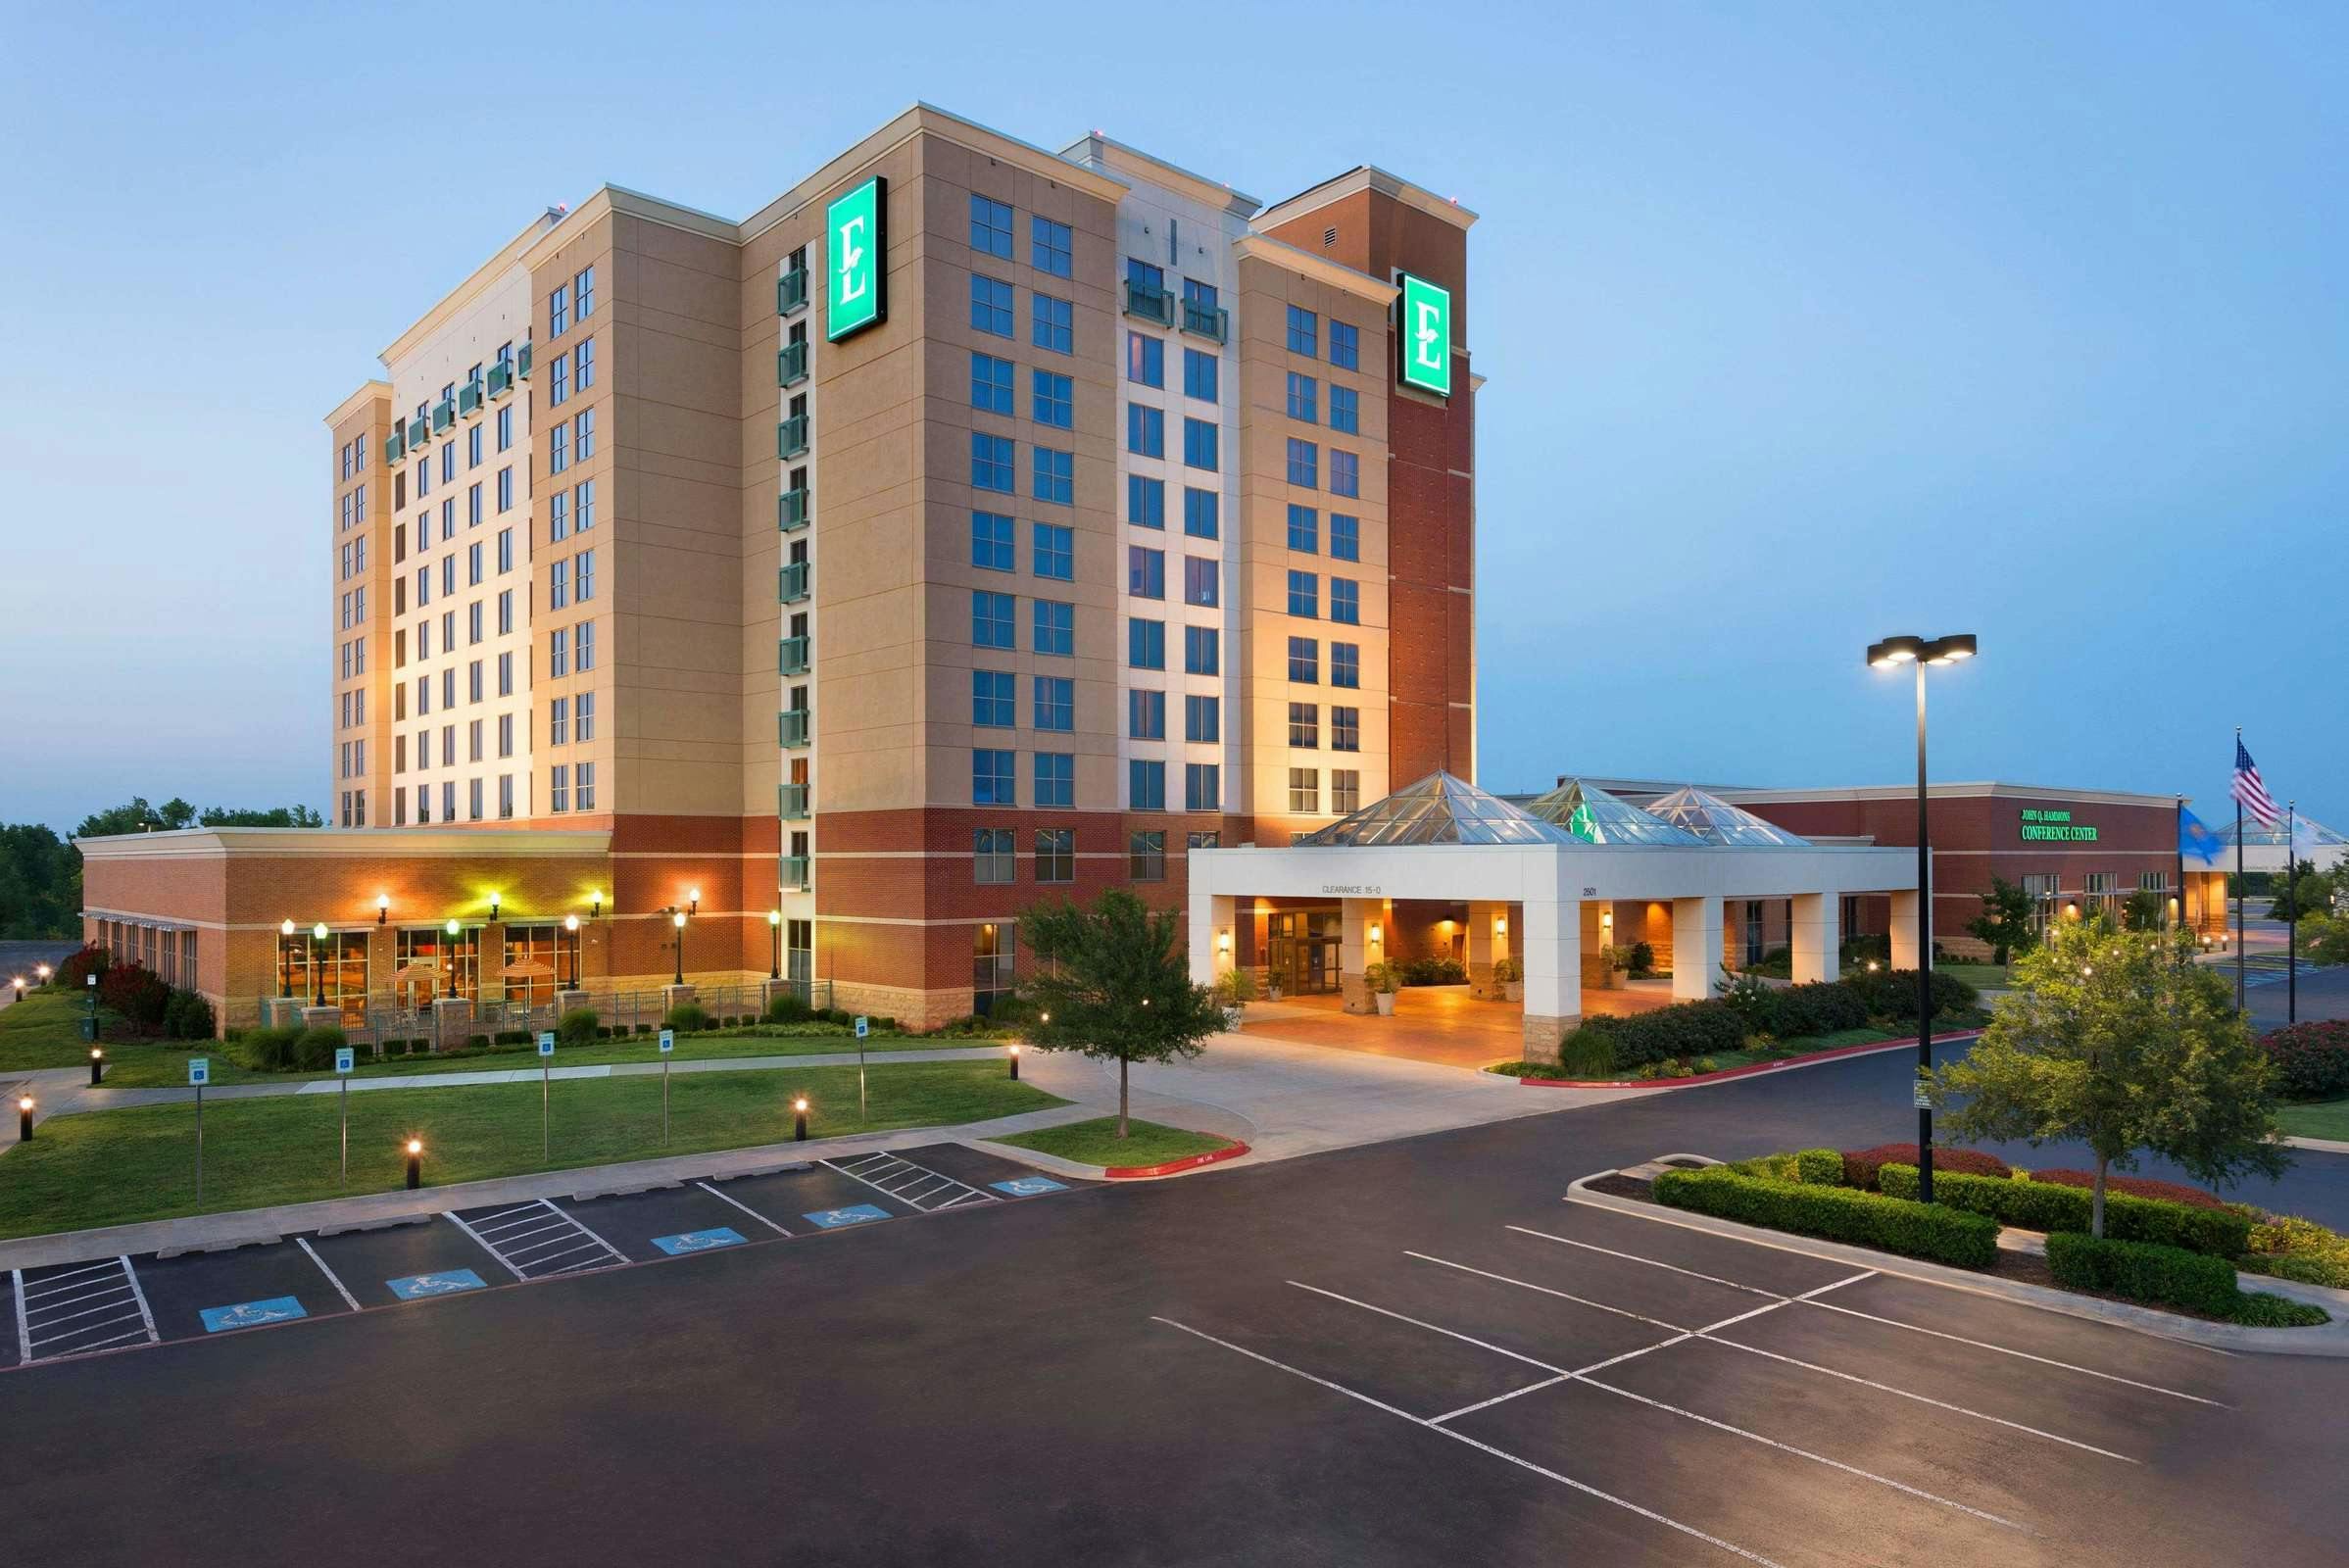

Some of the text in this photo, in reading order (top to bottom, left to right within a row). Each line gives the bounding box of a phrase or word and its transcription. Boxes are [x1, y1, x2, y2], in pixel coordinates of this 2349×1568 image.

[2022, 808, 2037, 821] JOHN
[2022, 825, 2097, 841] CONFERENCE CENTER
[1322, 885, 1362, 894] CLEARANCE
